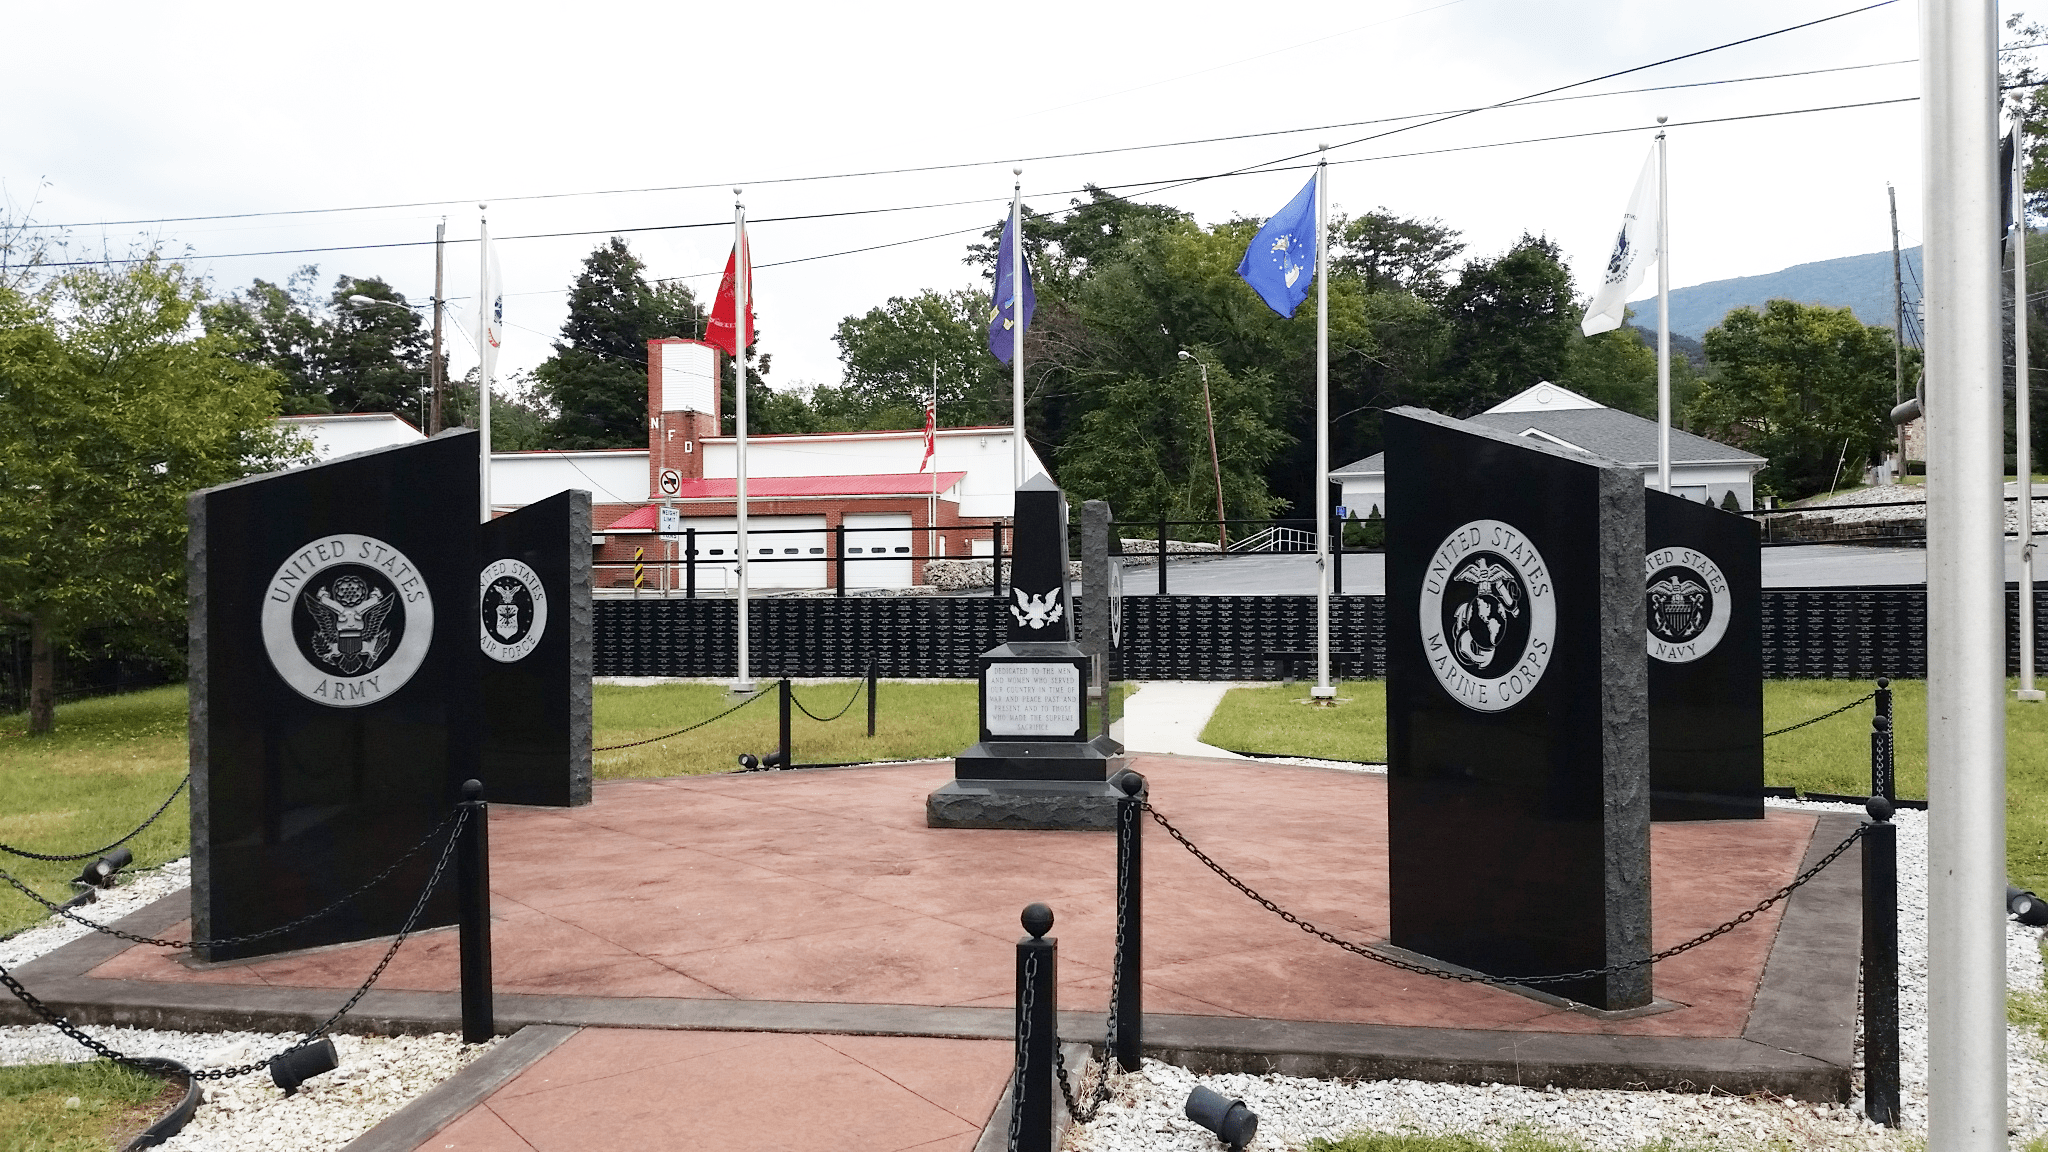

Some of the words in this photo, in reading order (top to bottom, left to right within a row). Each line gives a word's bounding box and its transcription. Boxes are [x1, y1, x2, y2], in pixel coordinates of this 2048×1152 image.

[271, 540, 345, 604] UNITED
[359, 541, 425, 604] STATES
[480, 562, 506, 592] NITED
[512, 563, 544, 601] STATES
[1427, 526, 1482, 597] UNITED
[1492, 527, 1549, 598] STATES
[1646, 551, 1674, 570] TED
[1682, 551, 1726, 594] STATES
[480, 635, 497, 655] AIR
[502, 635, 536, 659] FORCE
[1655, 642, 1696, 659] NAVY
[314, 675, 381, 700] ARMY
[1427, 632, 1488, 704] MARINE
[1498, 637, 1548, 702] CORPS
